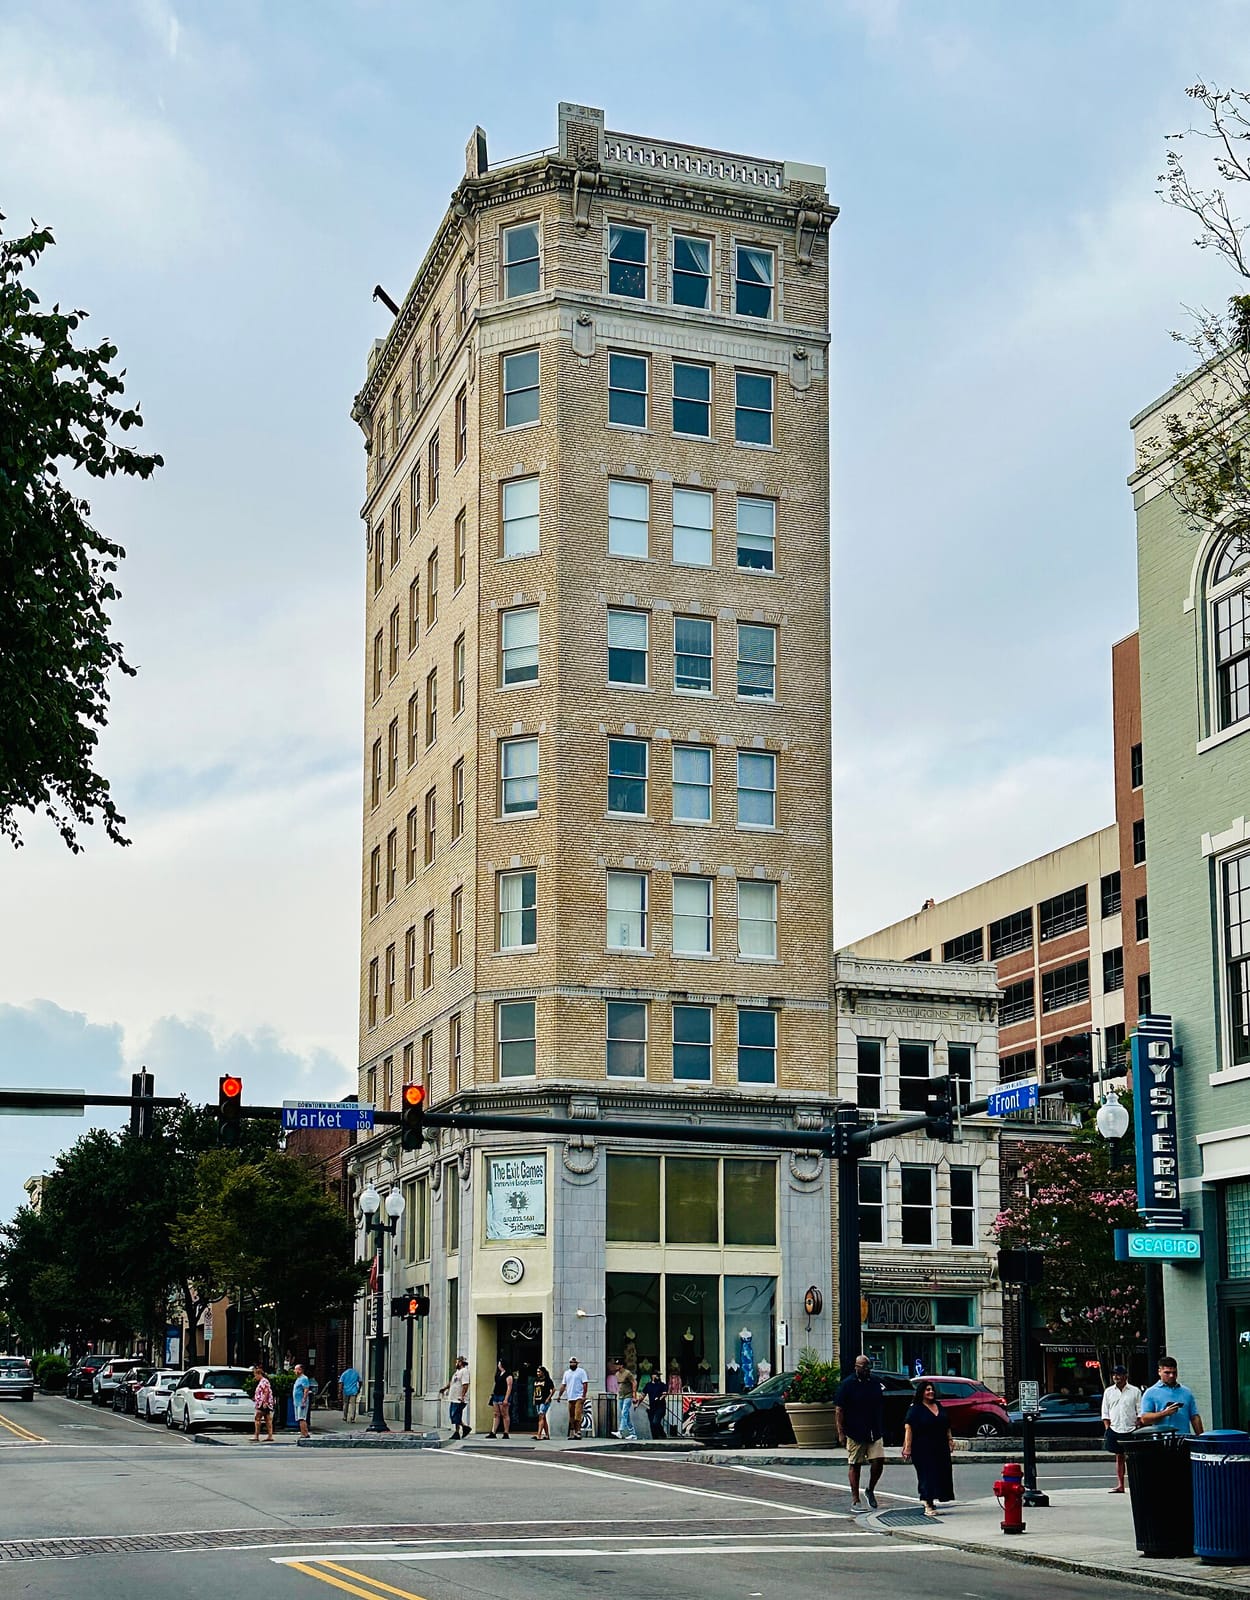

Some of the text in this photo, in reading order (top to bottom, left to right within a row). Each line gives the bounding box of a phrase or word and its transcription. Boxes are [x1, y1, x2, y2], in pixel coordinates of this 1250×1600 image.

[995, 1090, 1020, 1113] Front
[1029, 1086, 1035, 1096] St
[286, 1110, 368, 1127] Market St
[356, 1121, 371, 1130] 100
[1148, 1040, 1177, 1199] OYSTERS
[492, 1160, 544, 1180] The Exit Games
[1132, 1236, 1198, 1255] SEABIRD
[869, 1297, 930, 1324] TATTOO
